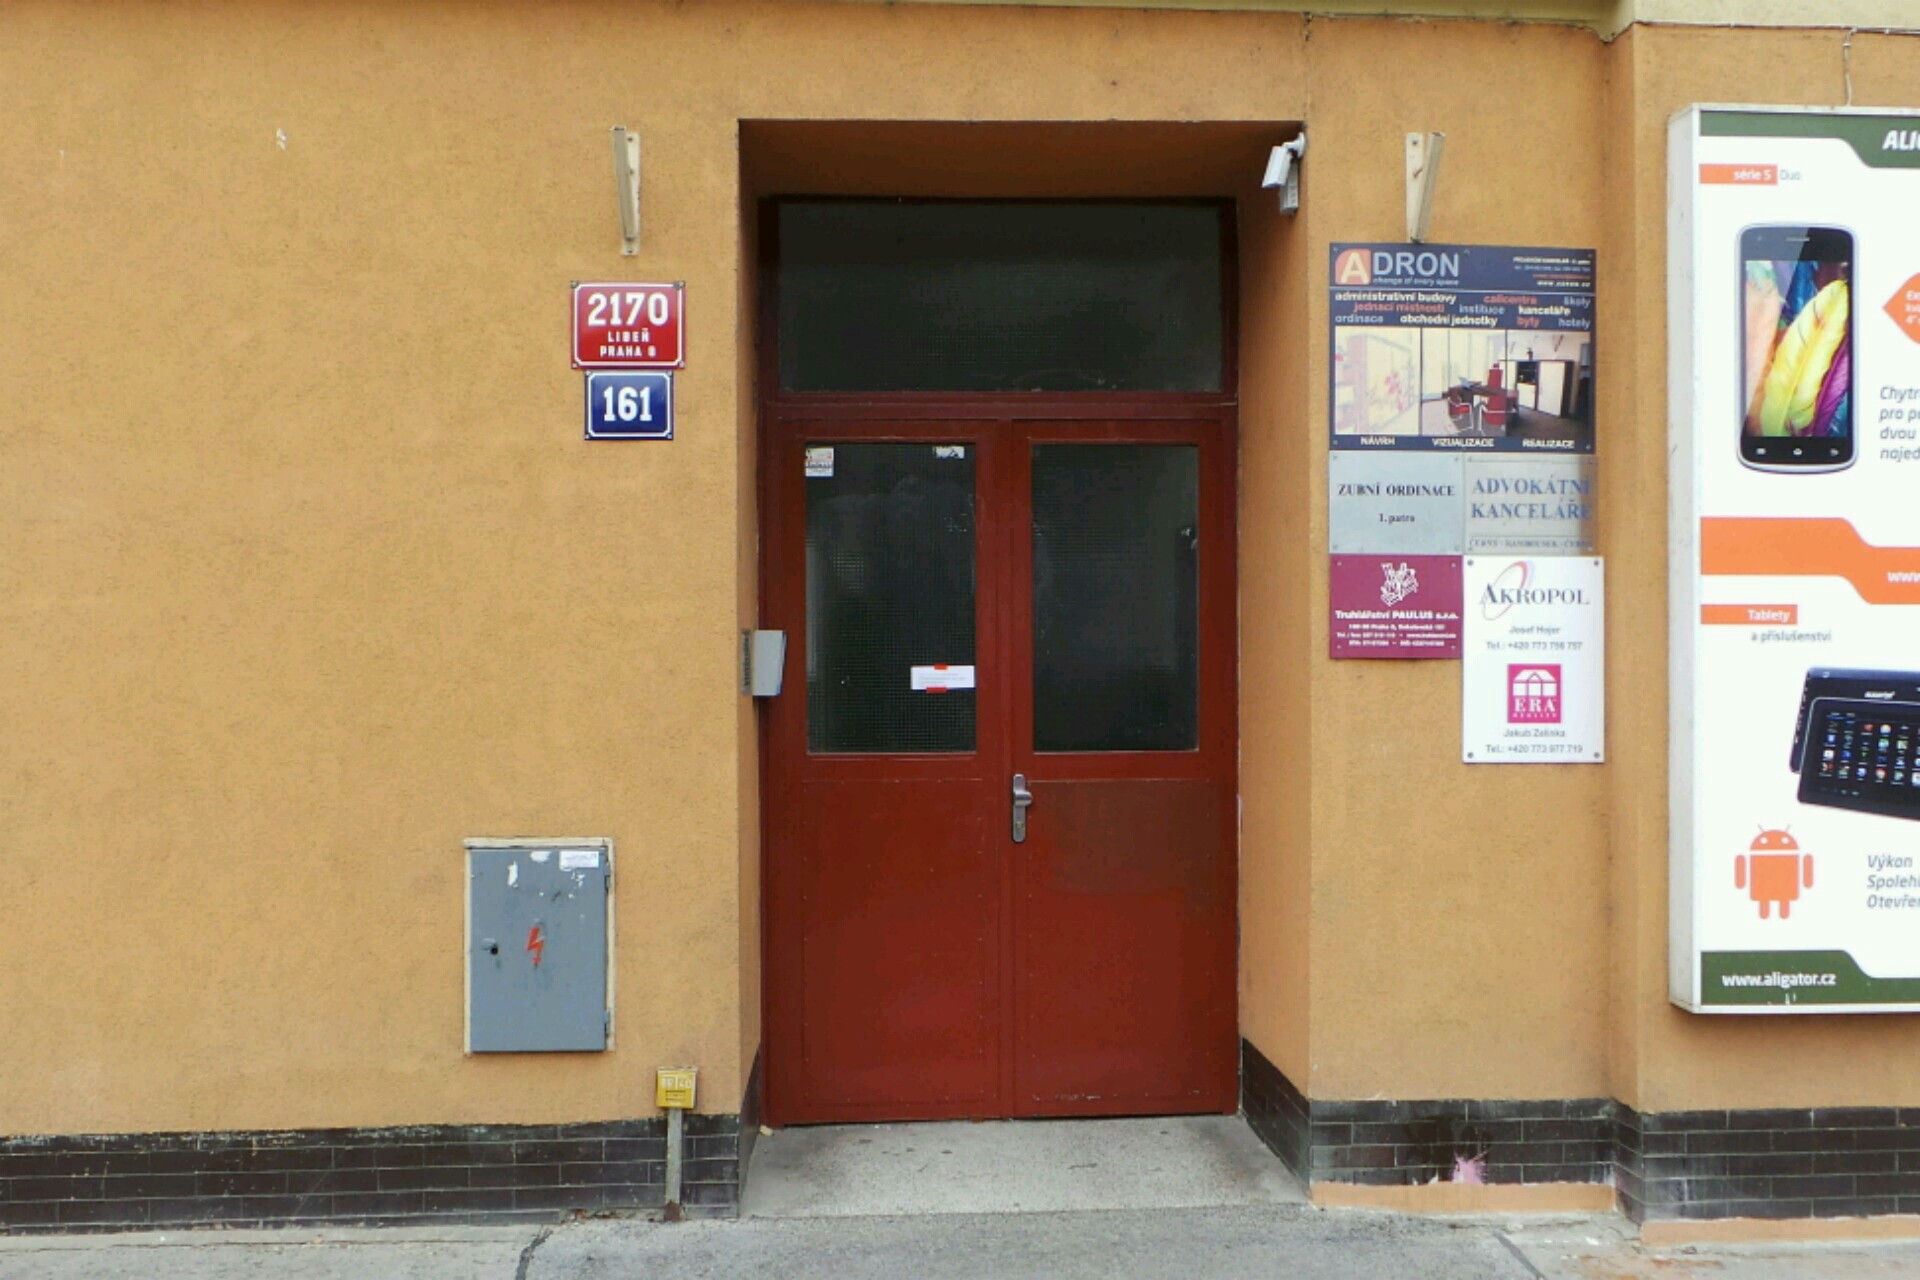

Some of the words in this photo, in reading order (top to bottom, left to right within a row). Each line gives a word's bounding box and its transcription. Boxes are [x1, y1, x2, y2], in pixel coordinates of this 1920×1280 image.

[1882, 130, 1920, 150] ALI
[1733, 168, 1762, 181] série
[1763, 169, 1772, 181] S
[1780, 169, 1802, 181] Duo
[1341, 251, 1459, 285] ADRON
[1335, 291, 1416, 302] administrativní
[1418, 292, 1457, 304] budovy
[588, 292, 668, 327] 2170
[1459, 304, 1505, 315] instituce
[1518, 304, 1571, 316] kanceláře
[1335, 314, 1384, 324] ordinace
[1400, 313, 1450, 325] obchodní
[1451, 315, 1498, 328] jednotky
[1516, 316, 1541, 328] byty
[1558, 317, 1591, 329] hotely
[608, 327, 650, 343] LIBEŇ
[600, 345, 643, 357] PRAHA
[648, 345, 657, 357] 8
[603, 386, 653, 421] 161
[1879, 408, 1904, 423] pro
[1880, 426, 1917, 439] dvou
[1360, 435, 1396, 446] NÁVRH
[1432, 437, 1494, 448] VIZUALIZACE
[1522, 439, 1575, 449] REALIZACE
[1338, 482, 1381, 497] ZUBNÍ
[1386, 485, 1455, 497] ORDINACE
[1472, 474, 1591, 495] ADVOKÁTNÍ
[1471, 498, 1592, 519] KANCELÁŘE
[1480, 582, 1591, 605] AKROPOL
[1335, 609, 1390, 620] Truhlářství
[1392, 610, 1433, 620] PAULUS
[1435, 611, 1460, 620] s.r.o.
[1748, 609, 1790, 623] Tablety
[1509, 625, 1535, 635] Josef
[1751, 632, 1758, 641] a
[1760, 629, 1832, 644] příslušenství
[1508, 641, 1530, 650] +420
[1531, 641, 1548, 650] 773
[1514, 698, 1557, 712] ERA
[1503, 728, 1531, 738] Jakub
[1508, 744, 1529, 753] +420
[1531, 744, 1548, 753] 773
[1867, 853, 1913, 871] Výkon
[1721, 971, 1837, 988] www.aligator.cz
